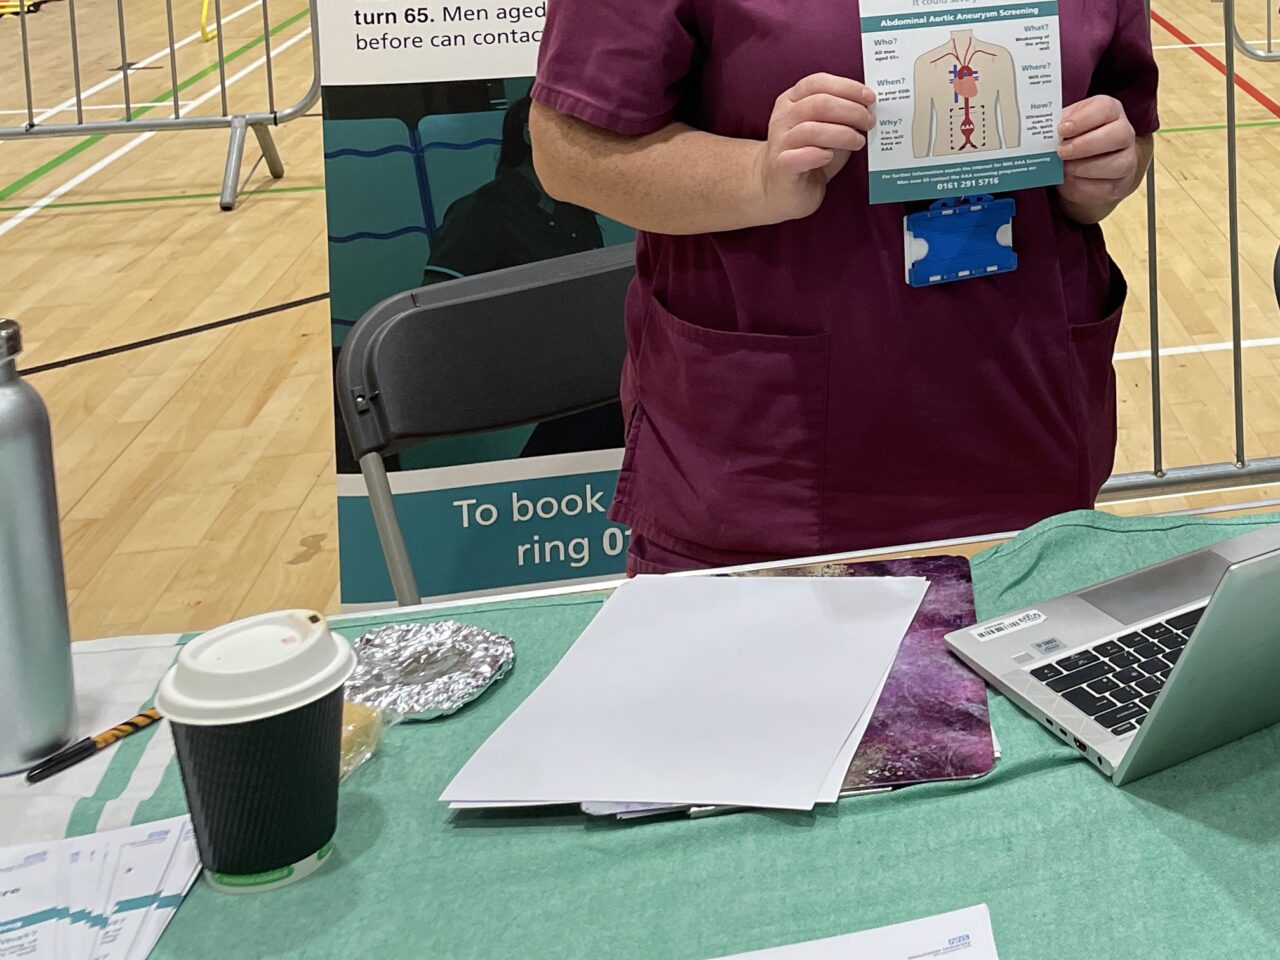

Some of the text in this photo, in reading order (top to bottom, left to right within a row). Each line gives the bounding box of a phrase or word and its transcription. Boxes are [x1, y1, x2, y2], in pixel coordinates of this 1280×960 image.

[354, 0, 547, 26] turn 65. Men aged
[881, 6, 1039, 27] Abdominal Aortic Aneurysm Screening
[356, 27, 543, 51] before can contac
[937, 182, 958, 190] 0161
[979, 177, 999, 185] 5716
[453, 484, 606, 528] To book
[517, 527, 631, 568] ring 0
